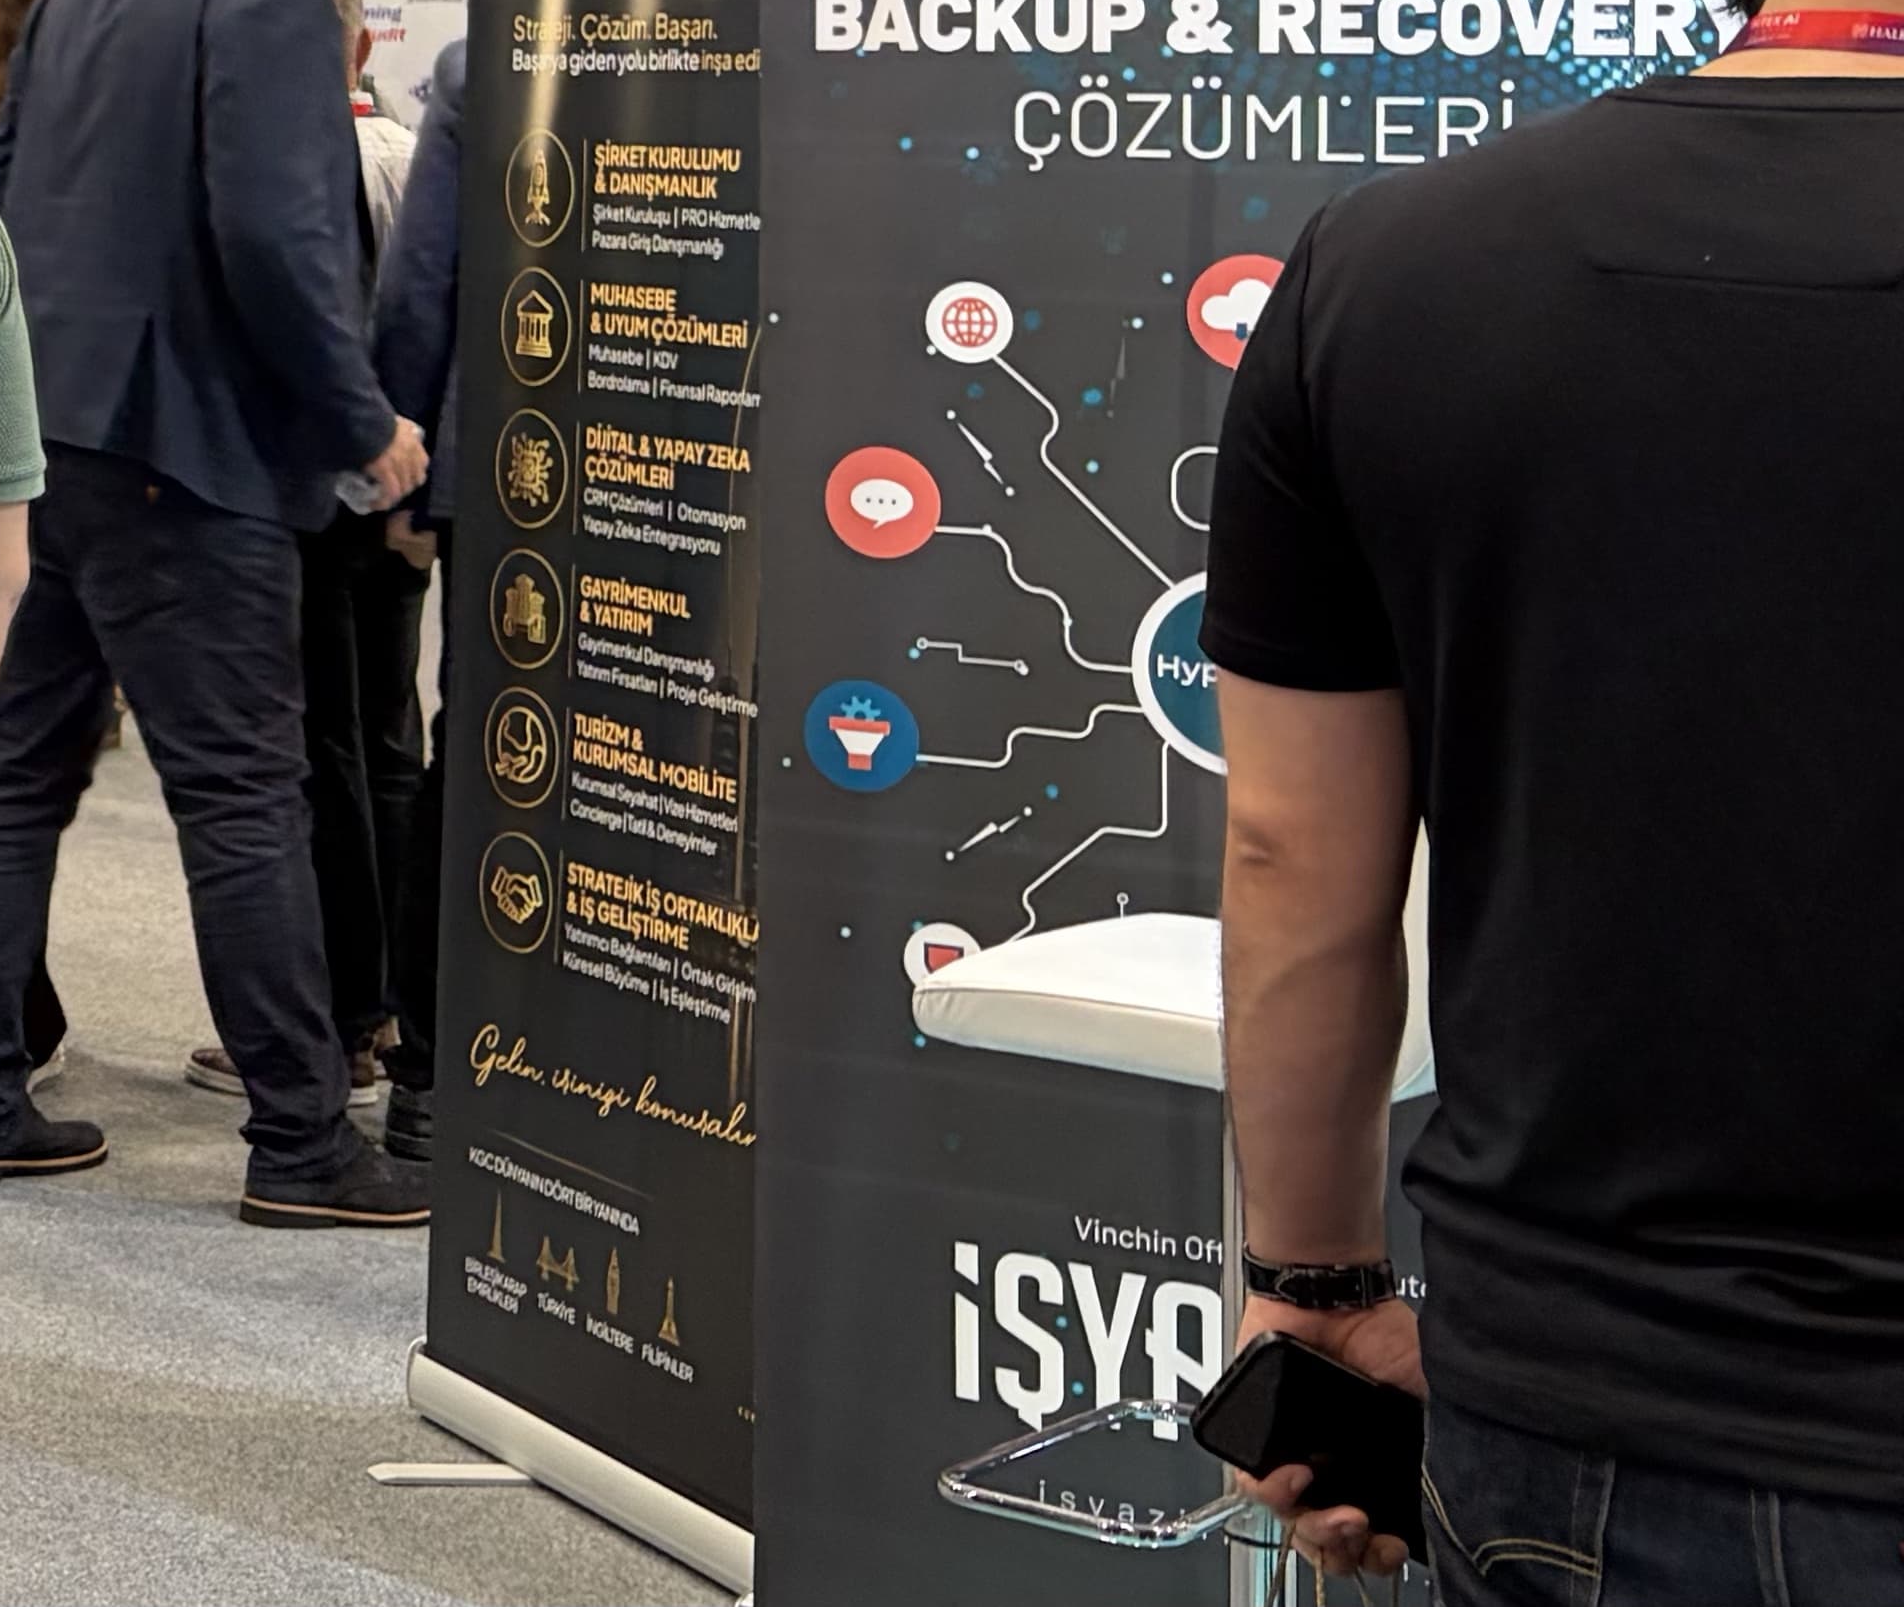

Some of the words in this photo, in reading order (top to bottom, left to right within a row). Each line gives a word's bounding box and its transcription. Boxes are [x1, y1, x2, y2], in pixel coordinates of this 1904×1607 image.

[581, 14, 651, 46] Çözüm.
[655, 13, 717, 46] Başarı.
[569, 53, 615, 76] giden
[617, 49, 647, 76] yolu
[649, 48, 699, 71] birlikte
[702, 50, 729, 76] inşa
[1014, 75, 1515, 172] ÇÖZÜMLERİ
[594, 139, 646, 169] ŞİRKET
[648, 148, 740, 171] KURULUMU
[594, 173, 606, 194] &
[610, 173, 717, 201] DANIŞMANLIK
[681, 208, 706, 228] PRO
[591, 283, 678, 311] MUHASEBE
[590, 313, 601, 334] &
[605, 313, 648, 338] UYUM
[651, 314, 748, 348] ÇÖZÜMLERİ
[653, 351, 678, 370] KDV
[586, 423, 634, 456] DİJİTAL
[640, 436, 649, 457] &
[654, 436, 705, 465] YAPAY
[708, 444, 750, 472] ZEKA
[584, 456, 674, 490] ÇÖZÜMLERİ
[677, 502, 746, 533] Otomasyon
[580, 575, 690, 618] GAYRİMENKUL
[579, 601, 590, 623] &
[593, 605, 652, 637] YATIRIM
[574, 713, 629, 745] TURİZM
[632, 729, 644, 751] &
[573, 740, 656, 784] KURUMSAL
[660, 762, 737, 803] MOBİLİTE
[567, 861, 644, 908] STRATEJİK
[646, 880, 660, 915] İŞ
[566, 892, 577, 914] &
[580, 894, 594, 925] İŞ
[597, 900, 690, 951] GELİŞTİRME
[1075, 1216, 1176, 1256] Vinchin
